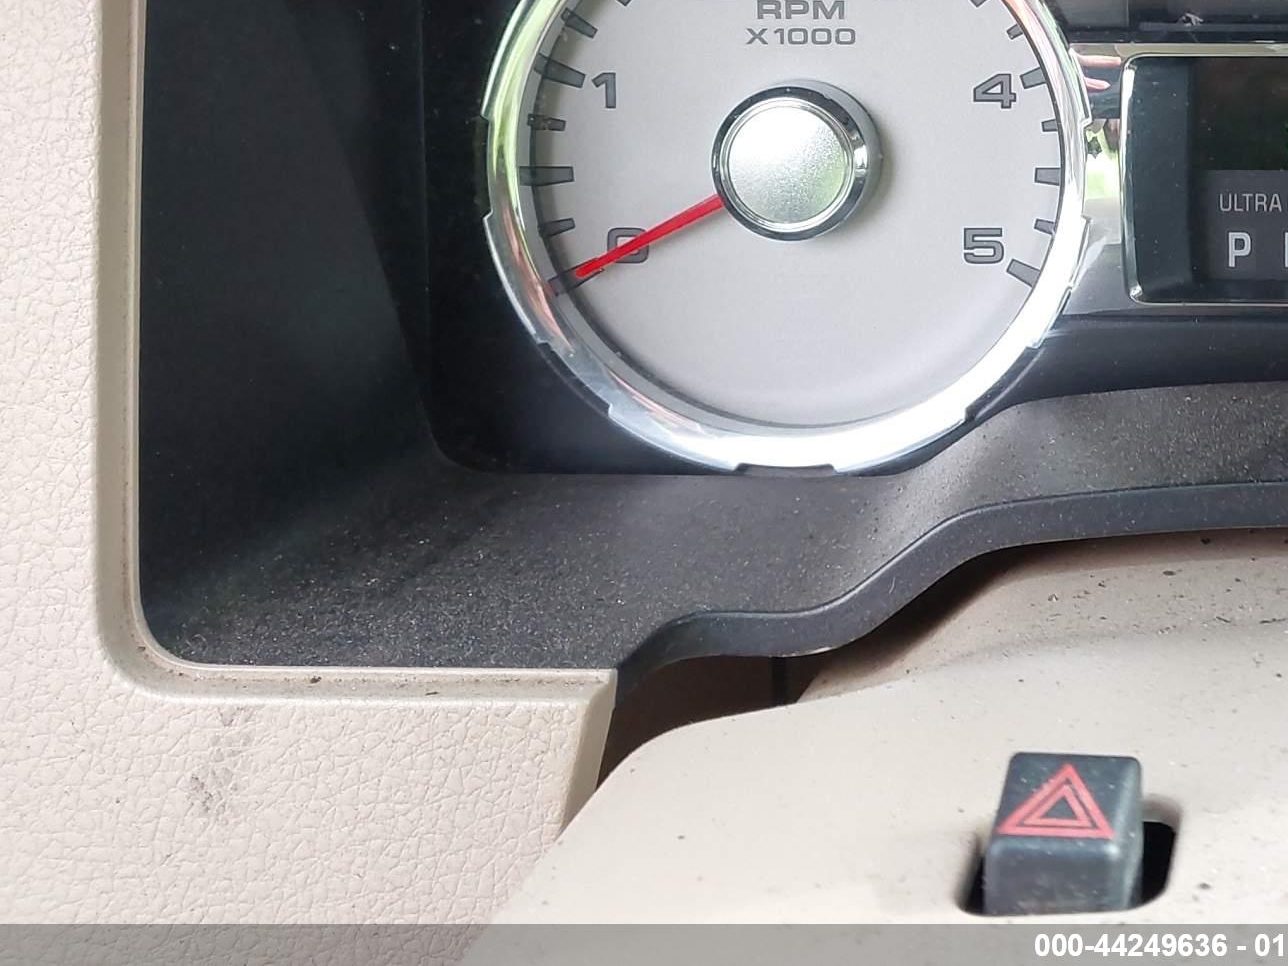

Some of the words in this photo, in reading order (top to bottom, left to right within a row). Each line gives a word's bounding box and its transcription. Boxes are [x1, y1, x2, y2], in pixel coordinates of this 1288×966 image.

[756, 0, 845, 20] RPM
[746, 28, 857, 46] X1000
[592, 72, 616, 109] 1
[973, 73, 1017, 109] 4
[1219, 194, 1282, 212] ULTRA
[964, 228, 1003, 264] 5
[1227, 232, 1251, 267] P
